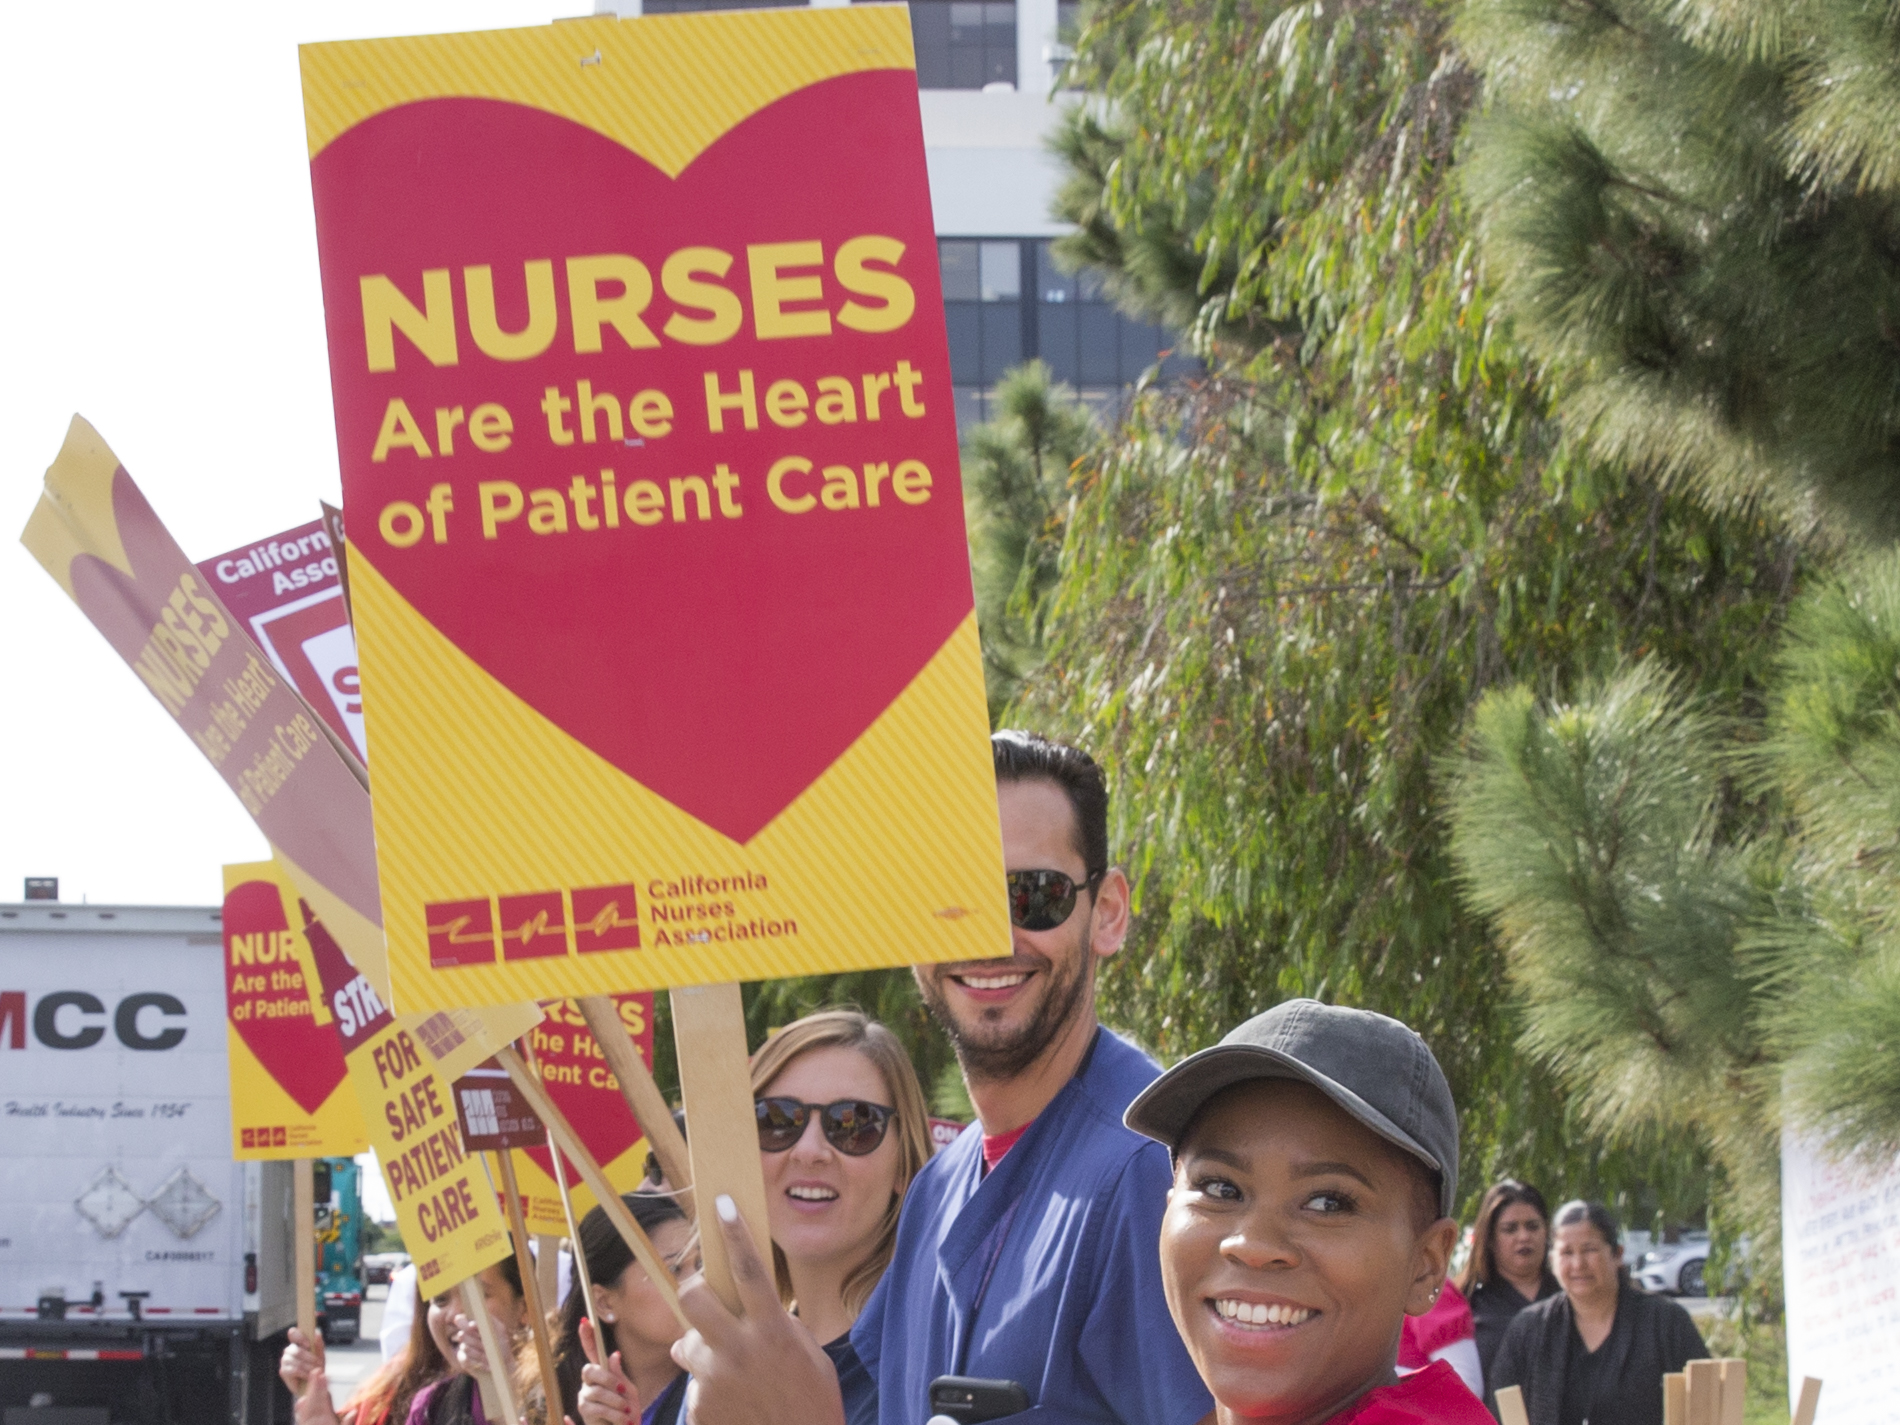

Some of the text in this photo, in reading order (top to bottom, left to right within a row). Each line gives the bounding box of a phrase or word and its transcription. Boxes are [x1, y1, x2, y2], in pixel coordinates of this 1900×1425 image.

[359, 235, 915, 372] NURSES
[371, 360, 926, 462] Are the Heart
[378, 483, 453, 547] of
[478, 463, 743, 539] Patient
[766, 455, 933, 514] Care
[134, 572, 230, 718] NURSES
[223, 651, 277, 719] Heart
[209, 700, 247, 742] the
[243, 737, 296, 804] Patient
[274, 713, 318, 761] Care
[648, 870, 768, 901] California
[650, 899, 736, 924] Nurses
[653, 917, 799, 948] Association
[232, 970, 303, 993] Are the
[233, 1000, 253, 1021] of
[372, 1029, 422, 1090] FOR
[384, 1074, 445, 1143] SAFE
[417, 1177, 480, 1244] CARE
